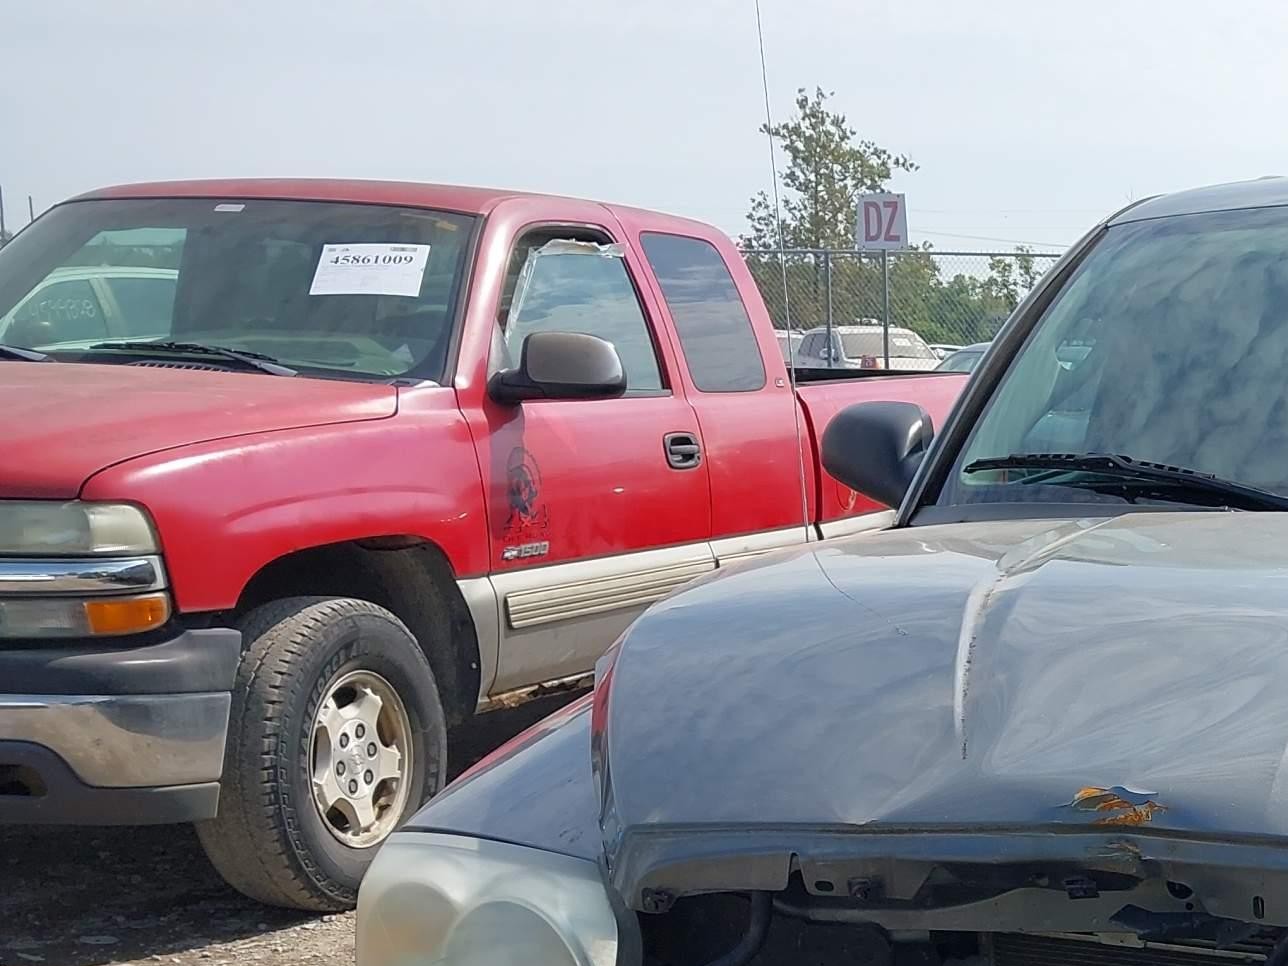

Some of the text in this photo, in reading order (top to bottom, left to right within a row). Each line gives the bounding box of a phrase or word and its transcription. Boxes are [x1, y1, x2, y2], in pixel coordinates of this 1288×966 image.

[863, 200, 901, 242] DZ
[329, 254, 414, 265] 45861009
[519, 541, 548, 557] 1500
